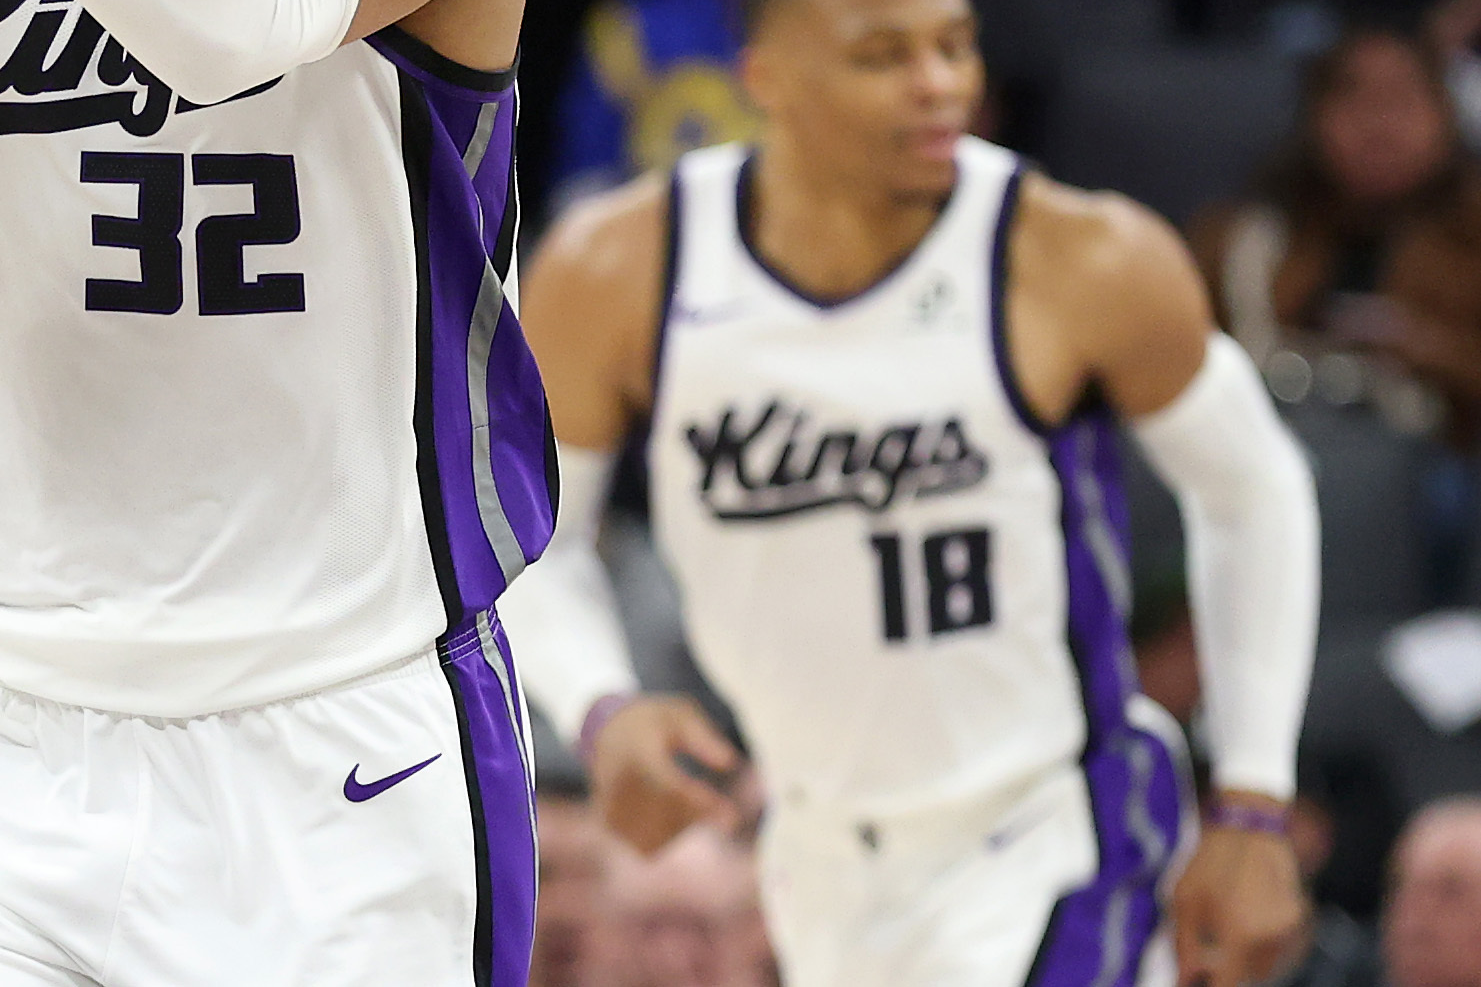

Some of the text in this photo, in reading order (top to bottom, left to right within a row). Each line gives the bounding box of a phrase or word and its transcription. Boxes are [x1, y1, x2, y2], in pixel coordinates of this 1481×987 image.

[80, 151, 305, 316] 32
[683, 399, 988, 523] Kings
[869, 528, 995, 644] 18
